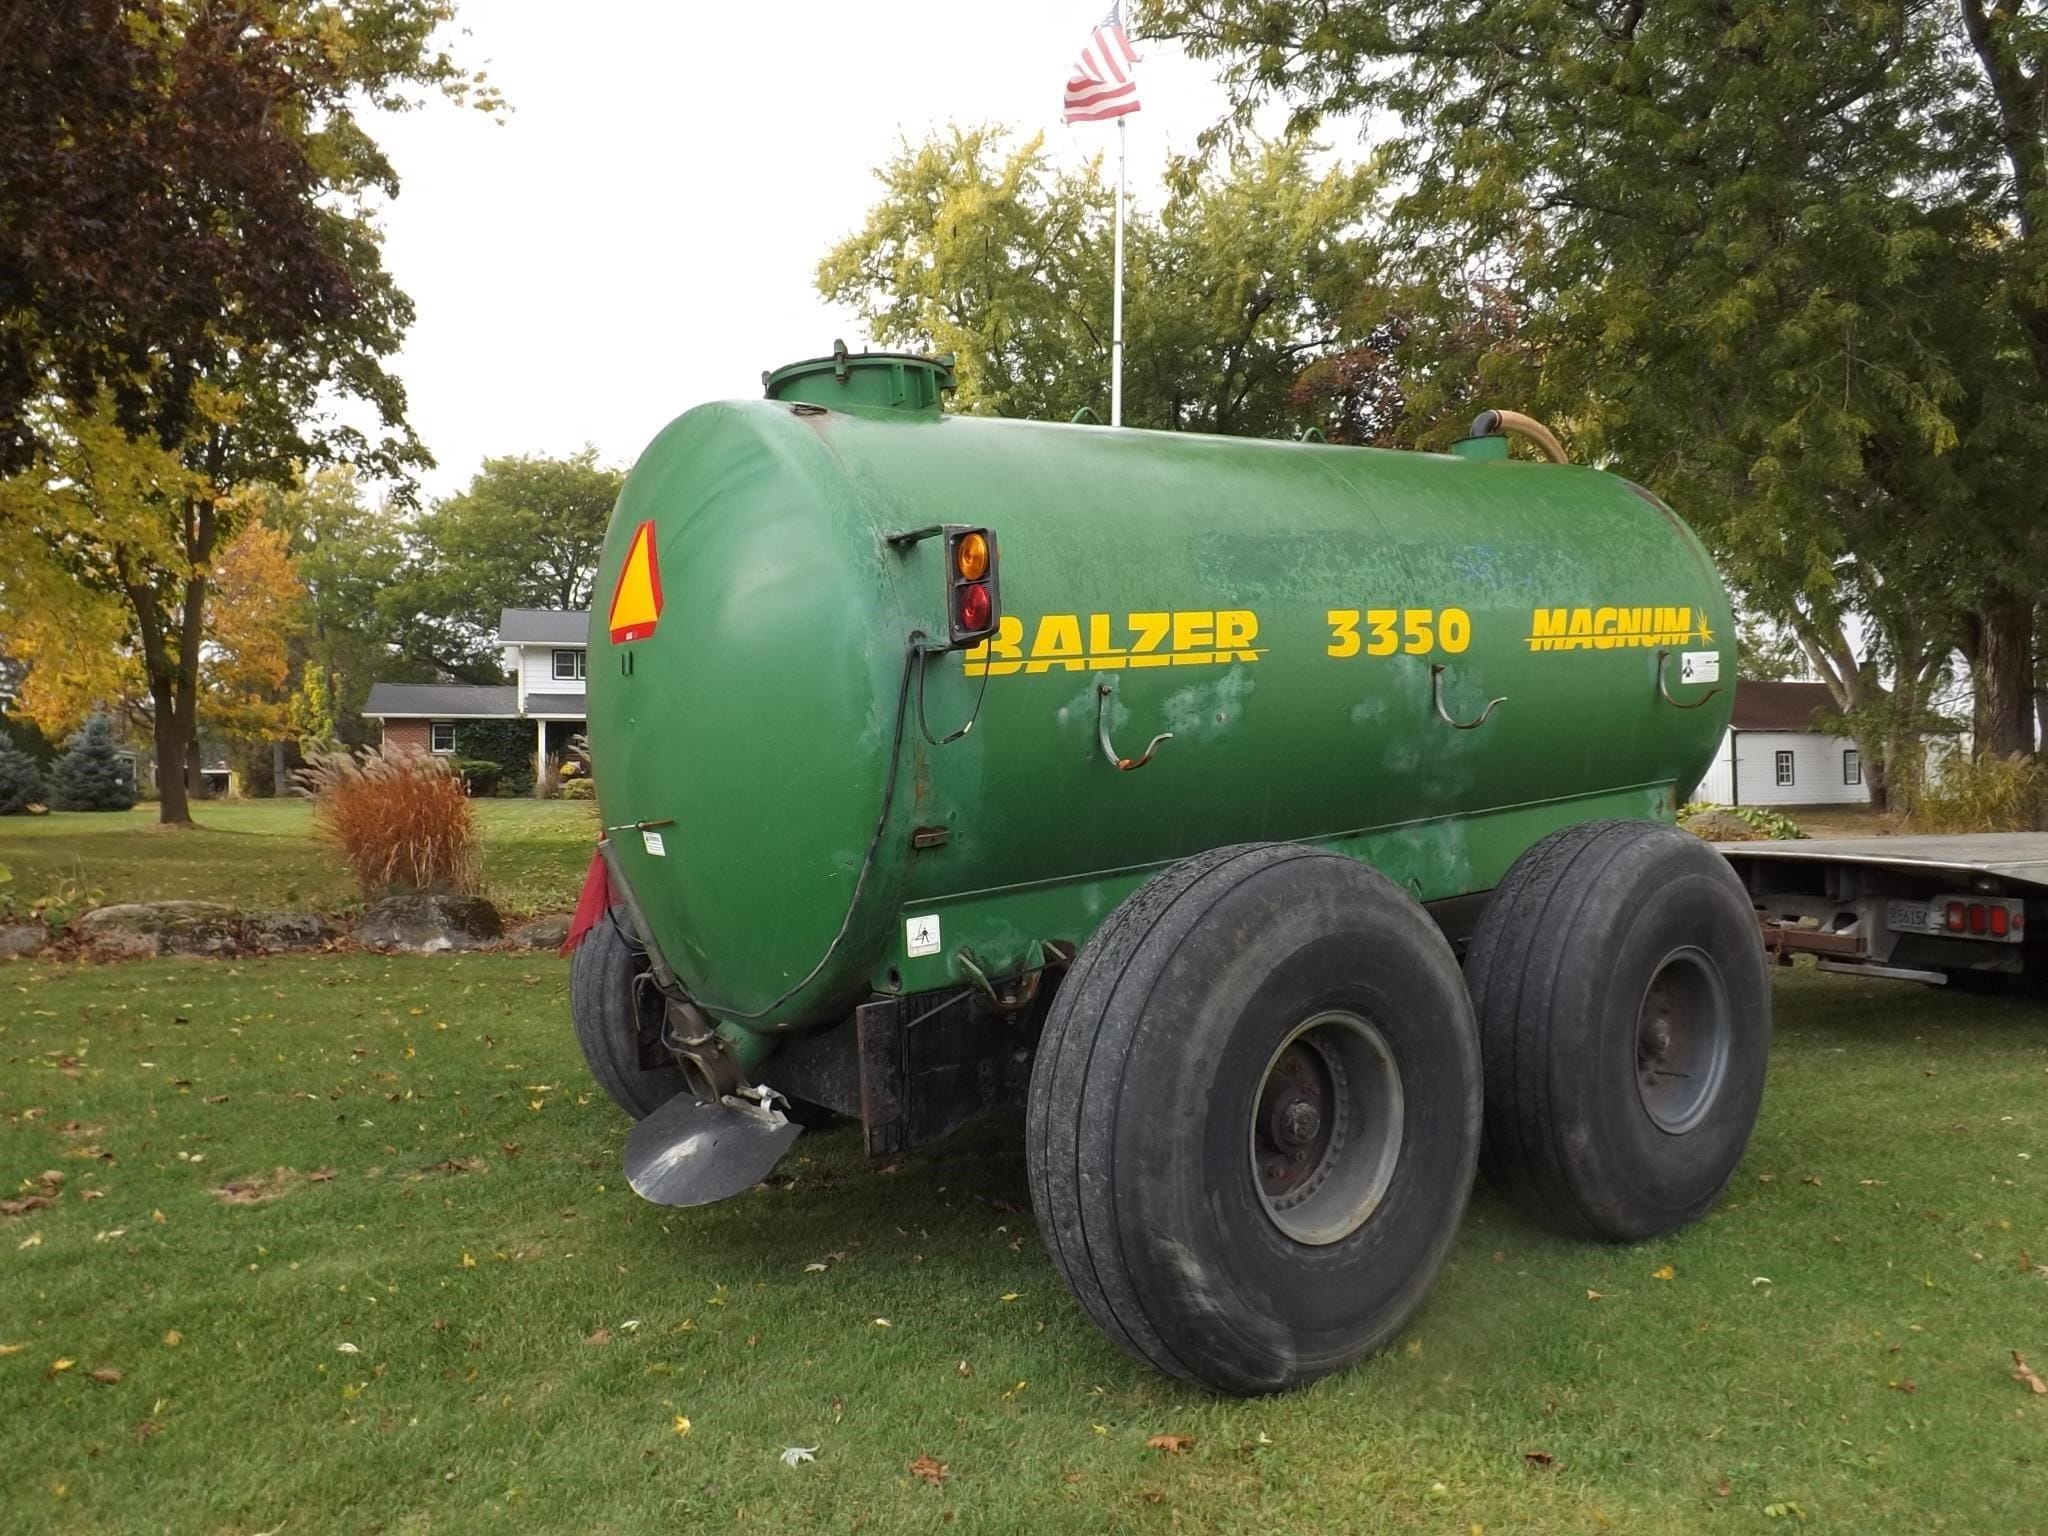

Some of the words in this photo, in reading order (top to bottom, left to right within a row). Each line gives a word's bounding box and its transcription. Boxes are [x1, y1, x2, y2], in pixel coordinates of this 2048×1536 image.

[962, 609, 1262, 677] BALZER
[1326, 607, 1472, 658] 3350
[1526, 606, 1692, 652] MAGNUM
